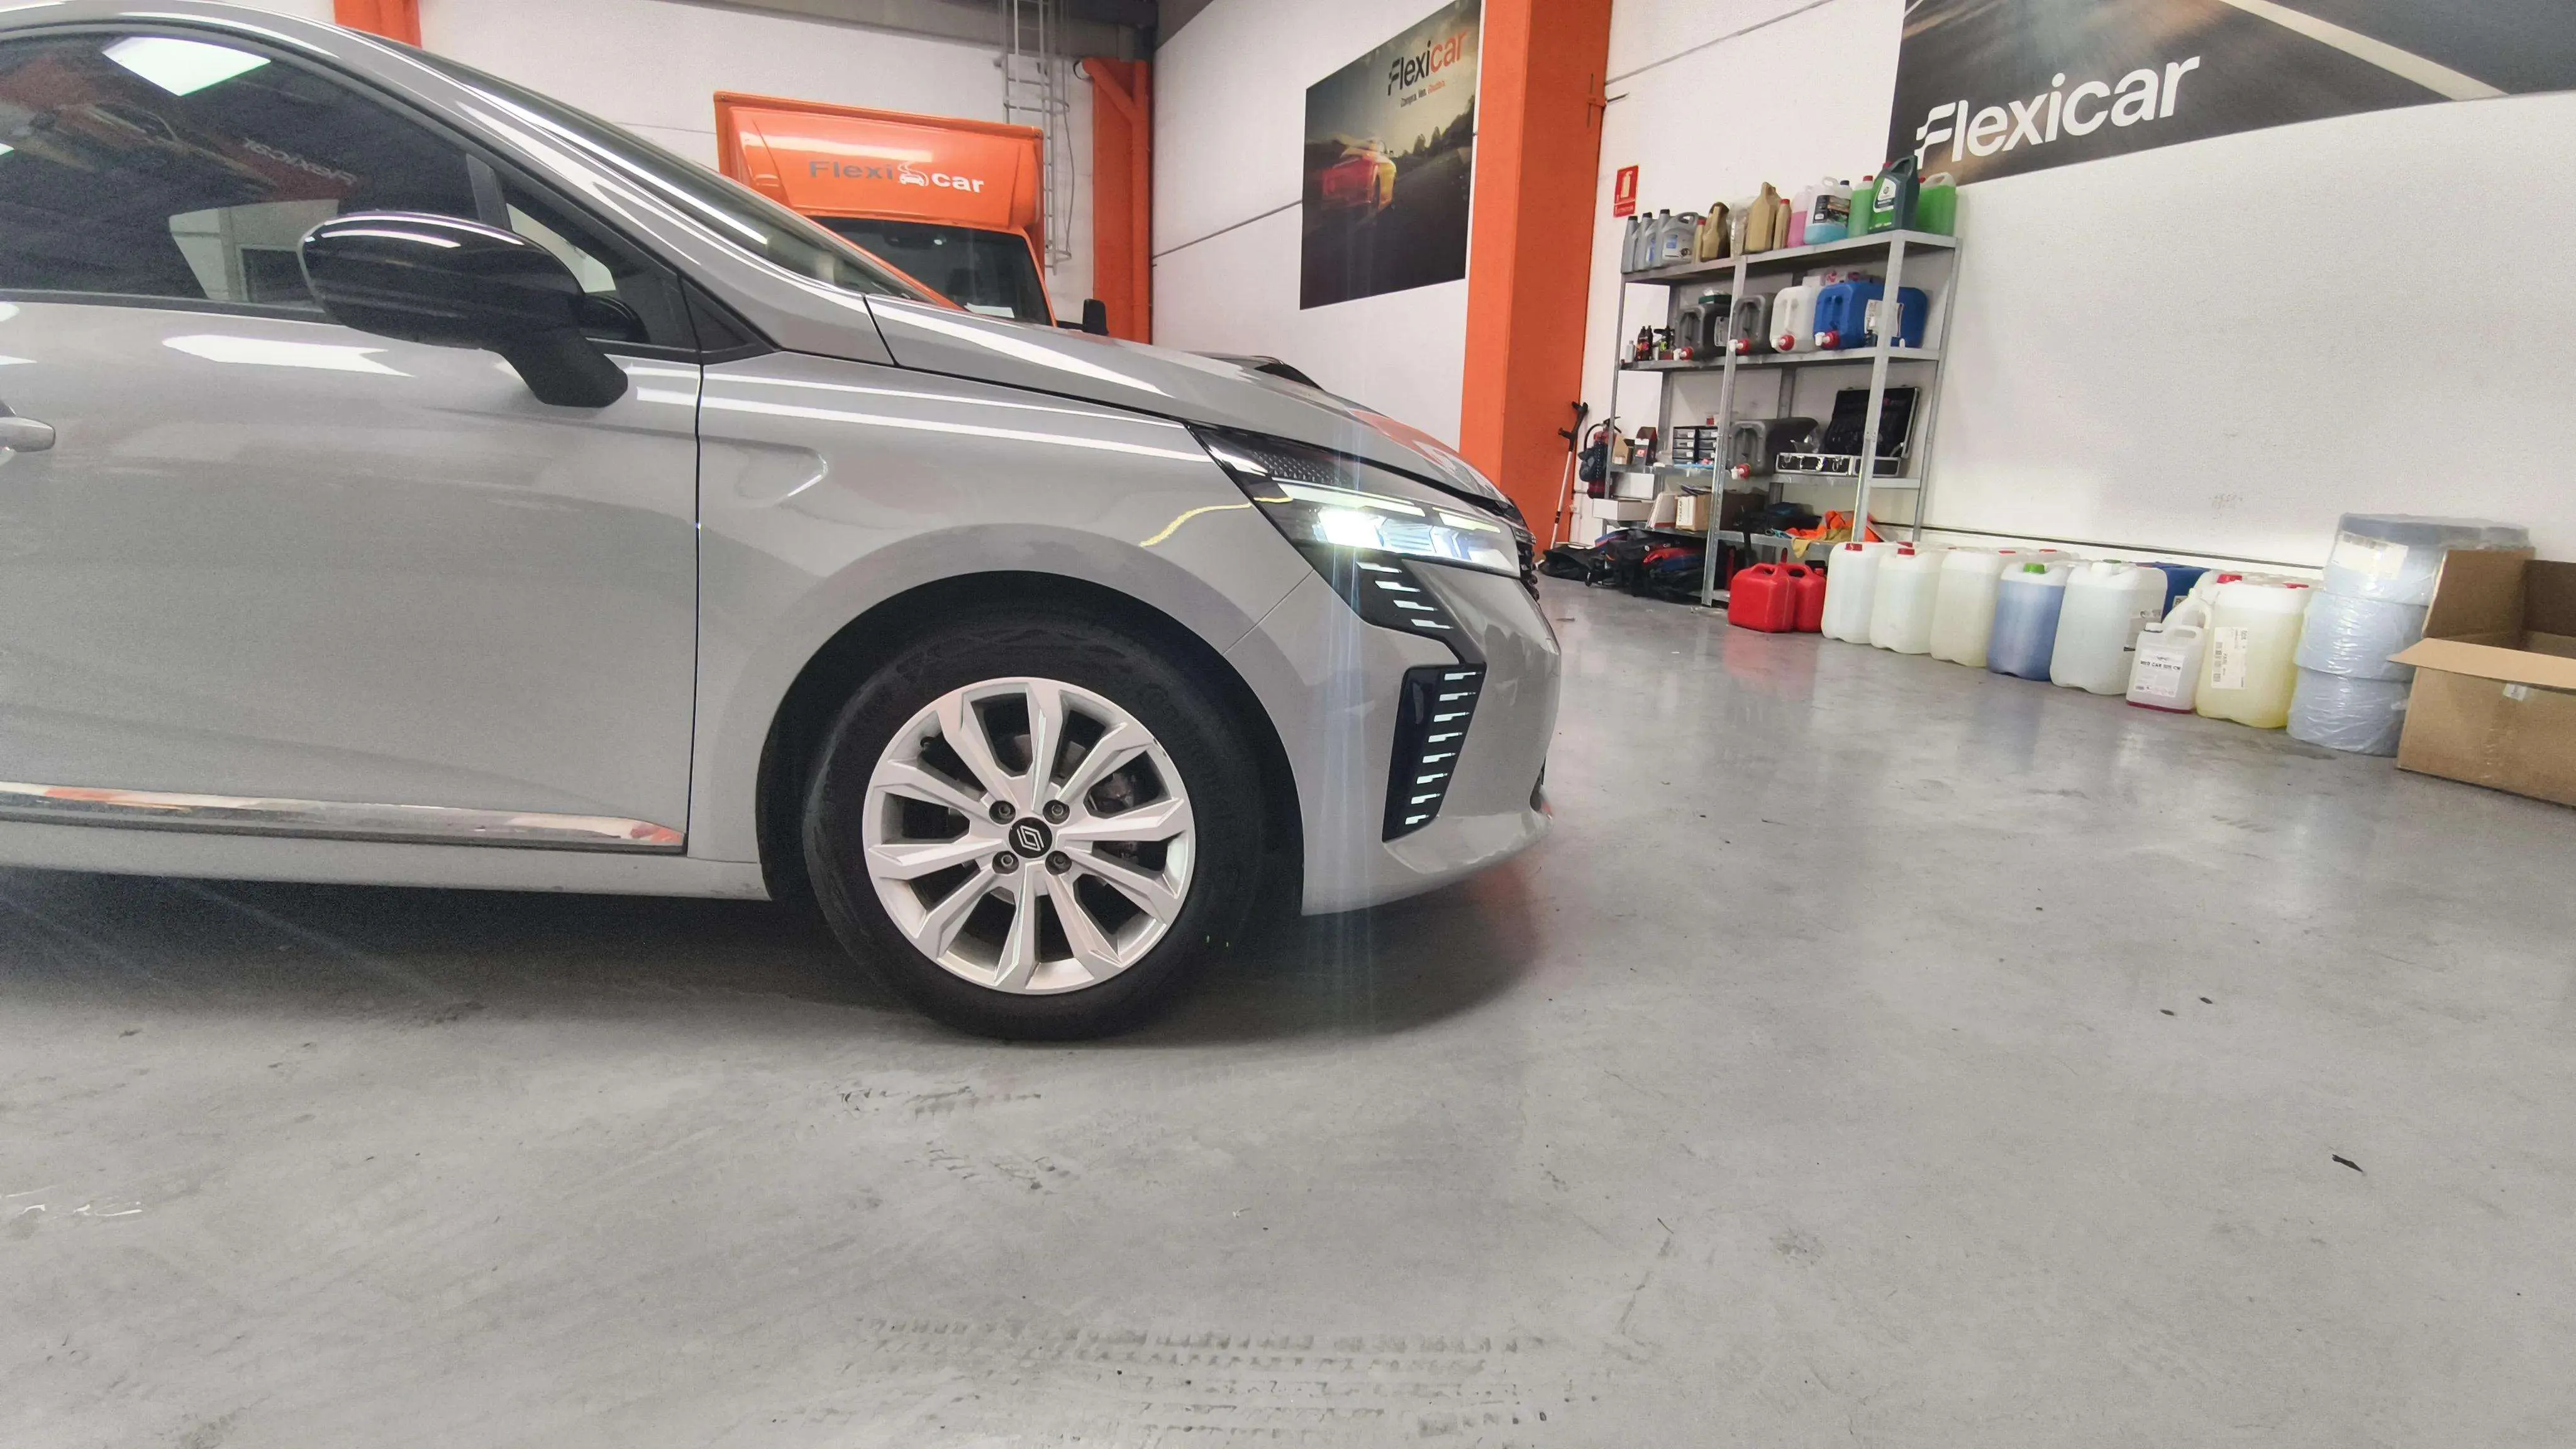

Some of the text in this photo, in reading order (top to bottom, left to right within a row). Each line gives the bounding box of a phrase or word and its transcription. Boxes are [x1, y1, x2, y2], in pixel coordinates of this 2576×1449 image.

[1387, 30, 1468, 96] Flexicar
[1914, 56, 2201, 170] Flexicar
[808, 161, 984, 193] Flexi car
